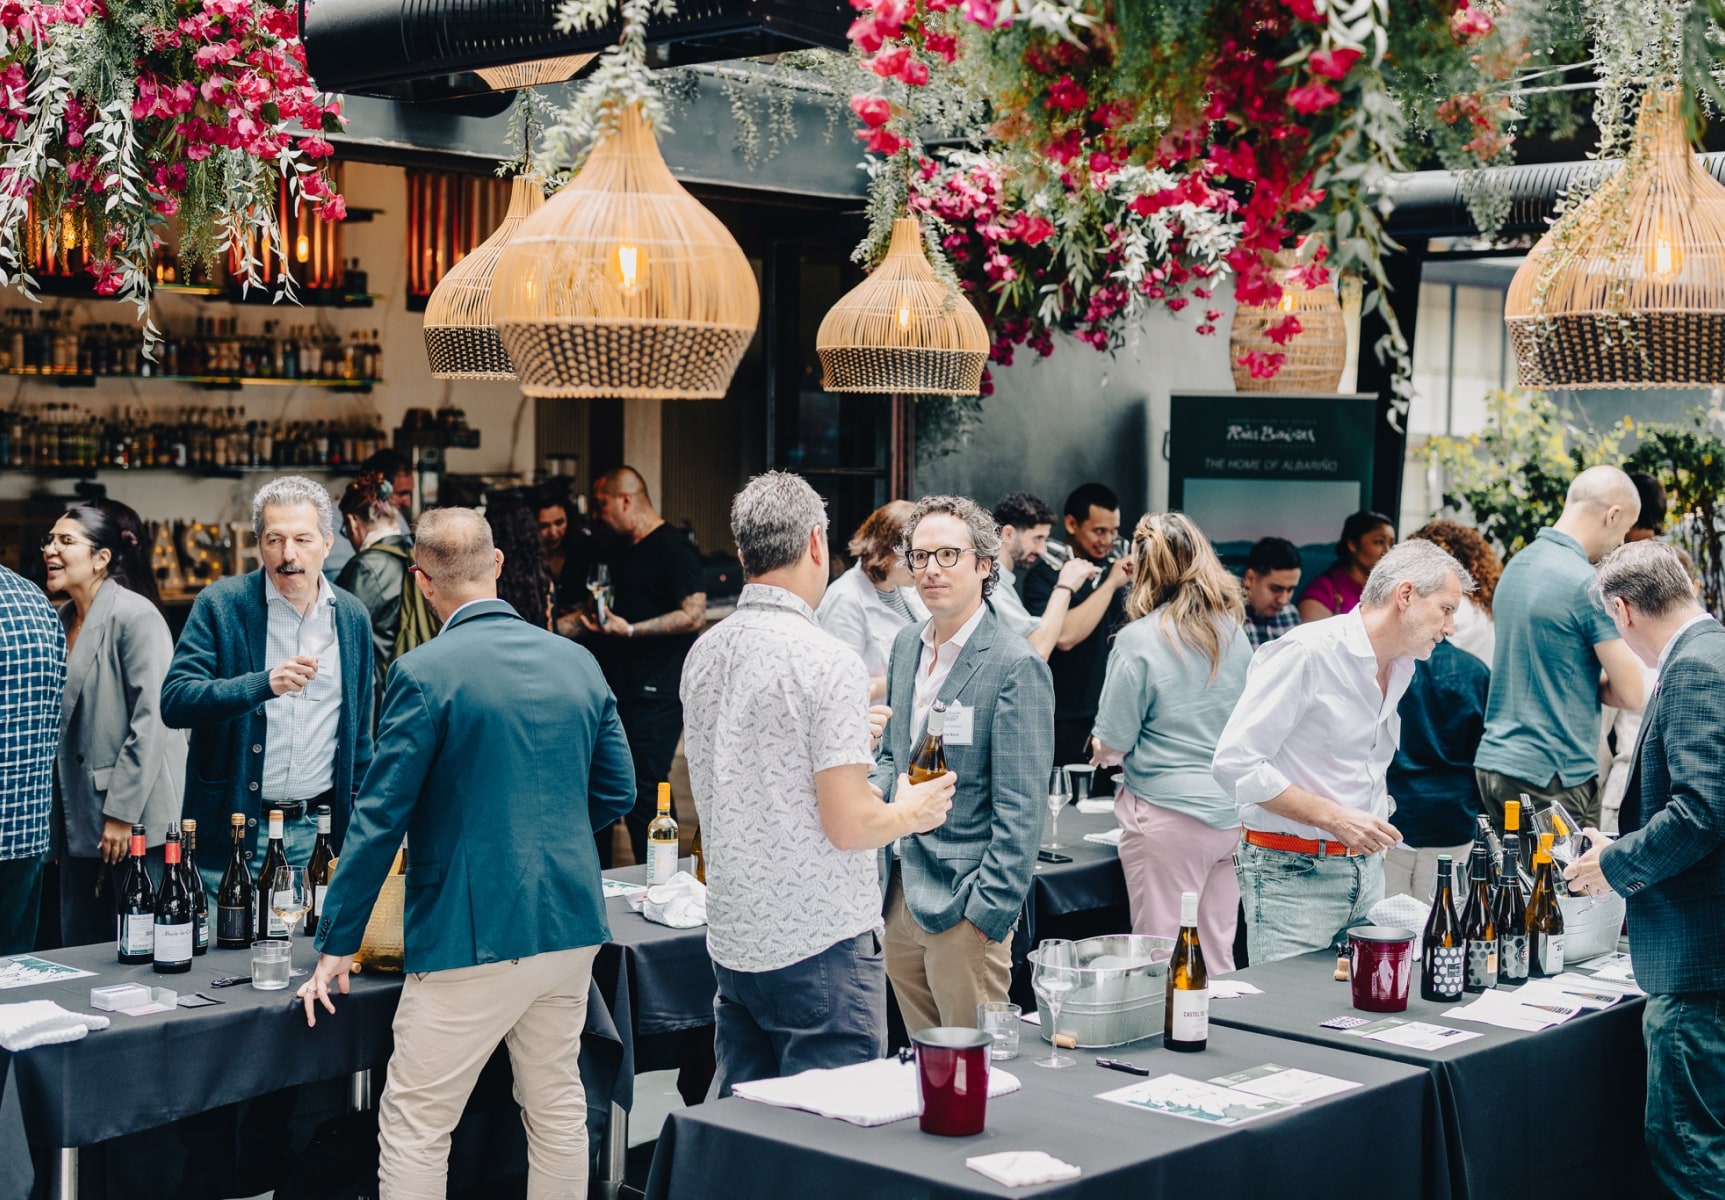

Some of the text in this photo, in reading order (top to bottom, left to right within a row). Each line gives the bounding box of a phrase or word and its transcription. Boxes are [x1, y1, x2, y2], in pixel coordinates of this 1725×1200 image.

[1204, 457, 1339, 472] THE HOME OF ALBARIÑO
